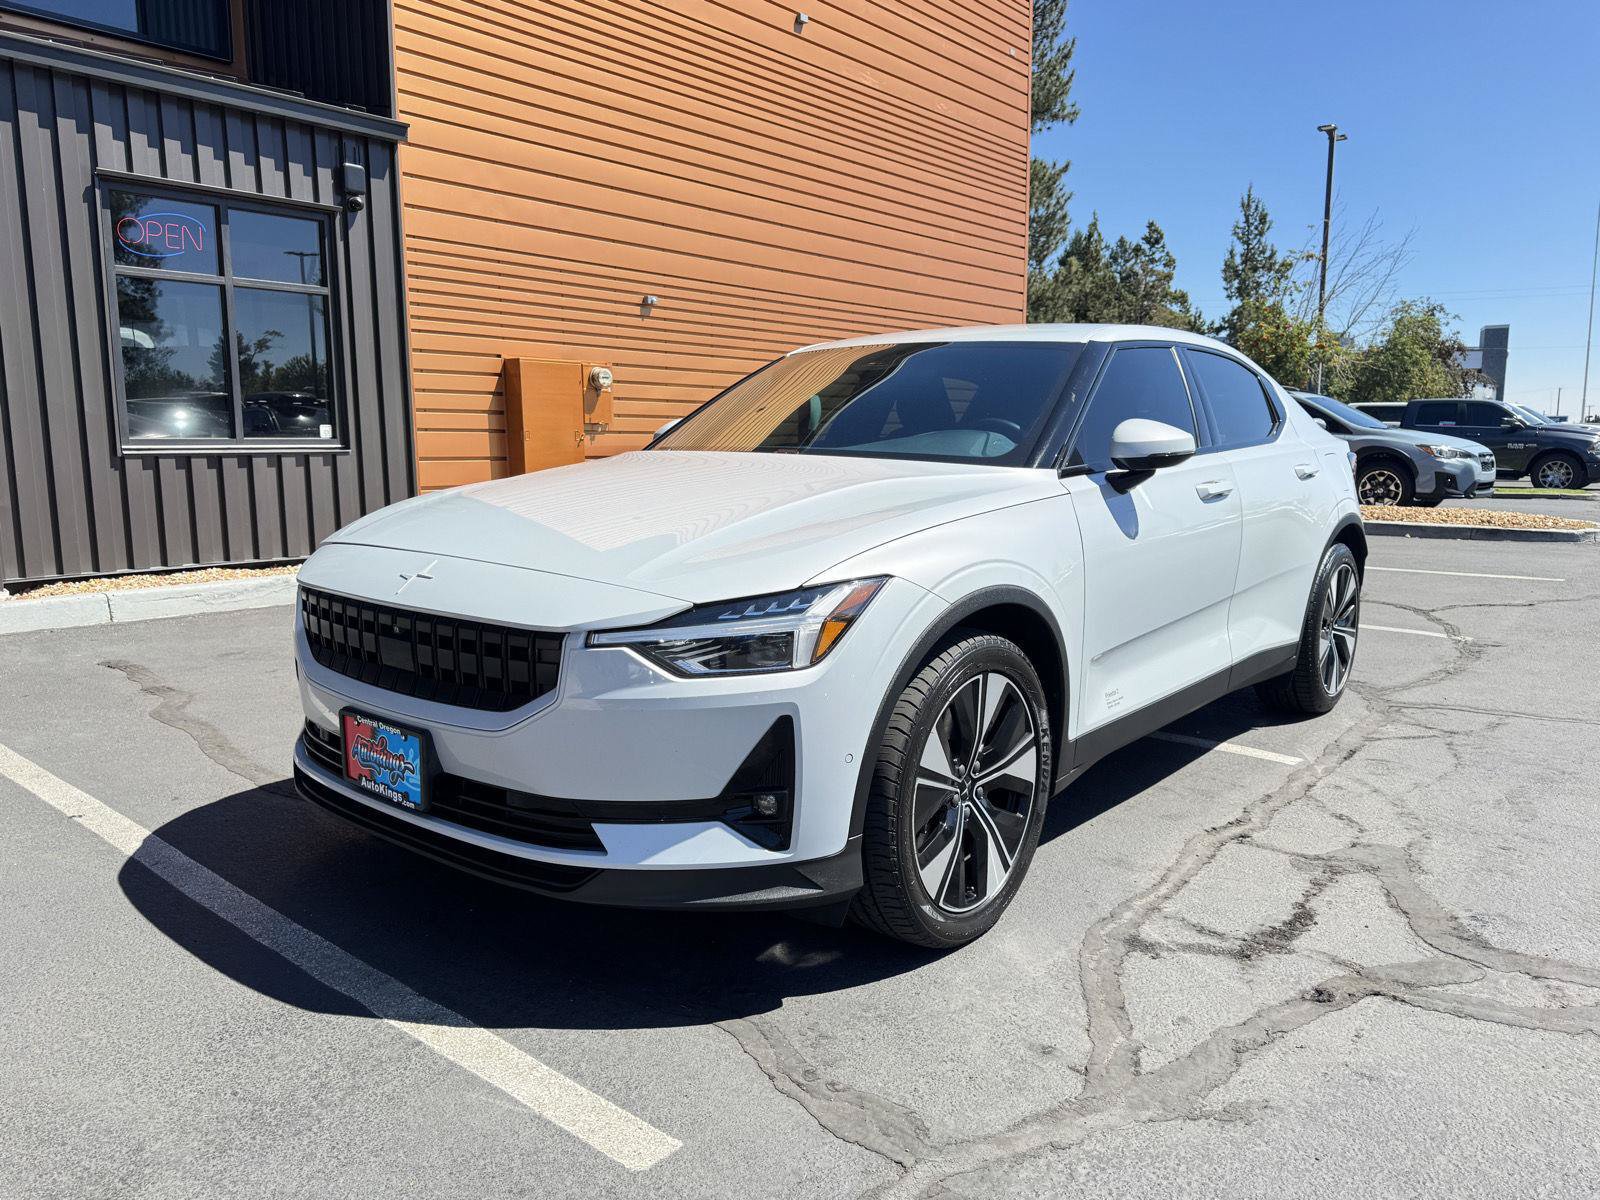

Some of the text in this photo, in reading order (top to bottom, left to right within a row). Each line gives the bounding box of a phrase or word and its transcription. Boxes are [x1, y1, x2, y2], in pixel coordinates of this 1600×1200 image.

[116, 217, 204, 251] OPEN
[356, 715, 401, 735] Central Oregon
[1041, 728, 1049, 793] KENDA
[361, 777, 415, 809] AutoKings.com
